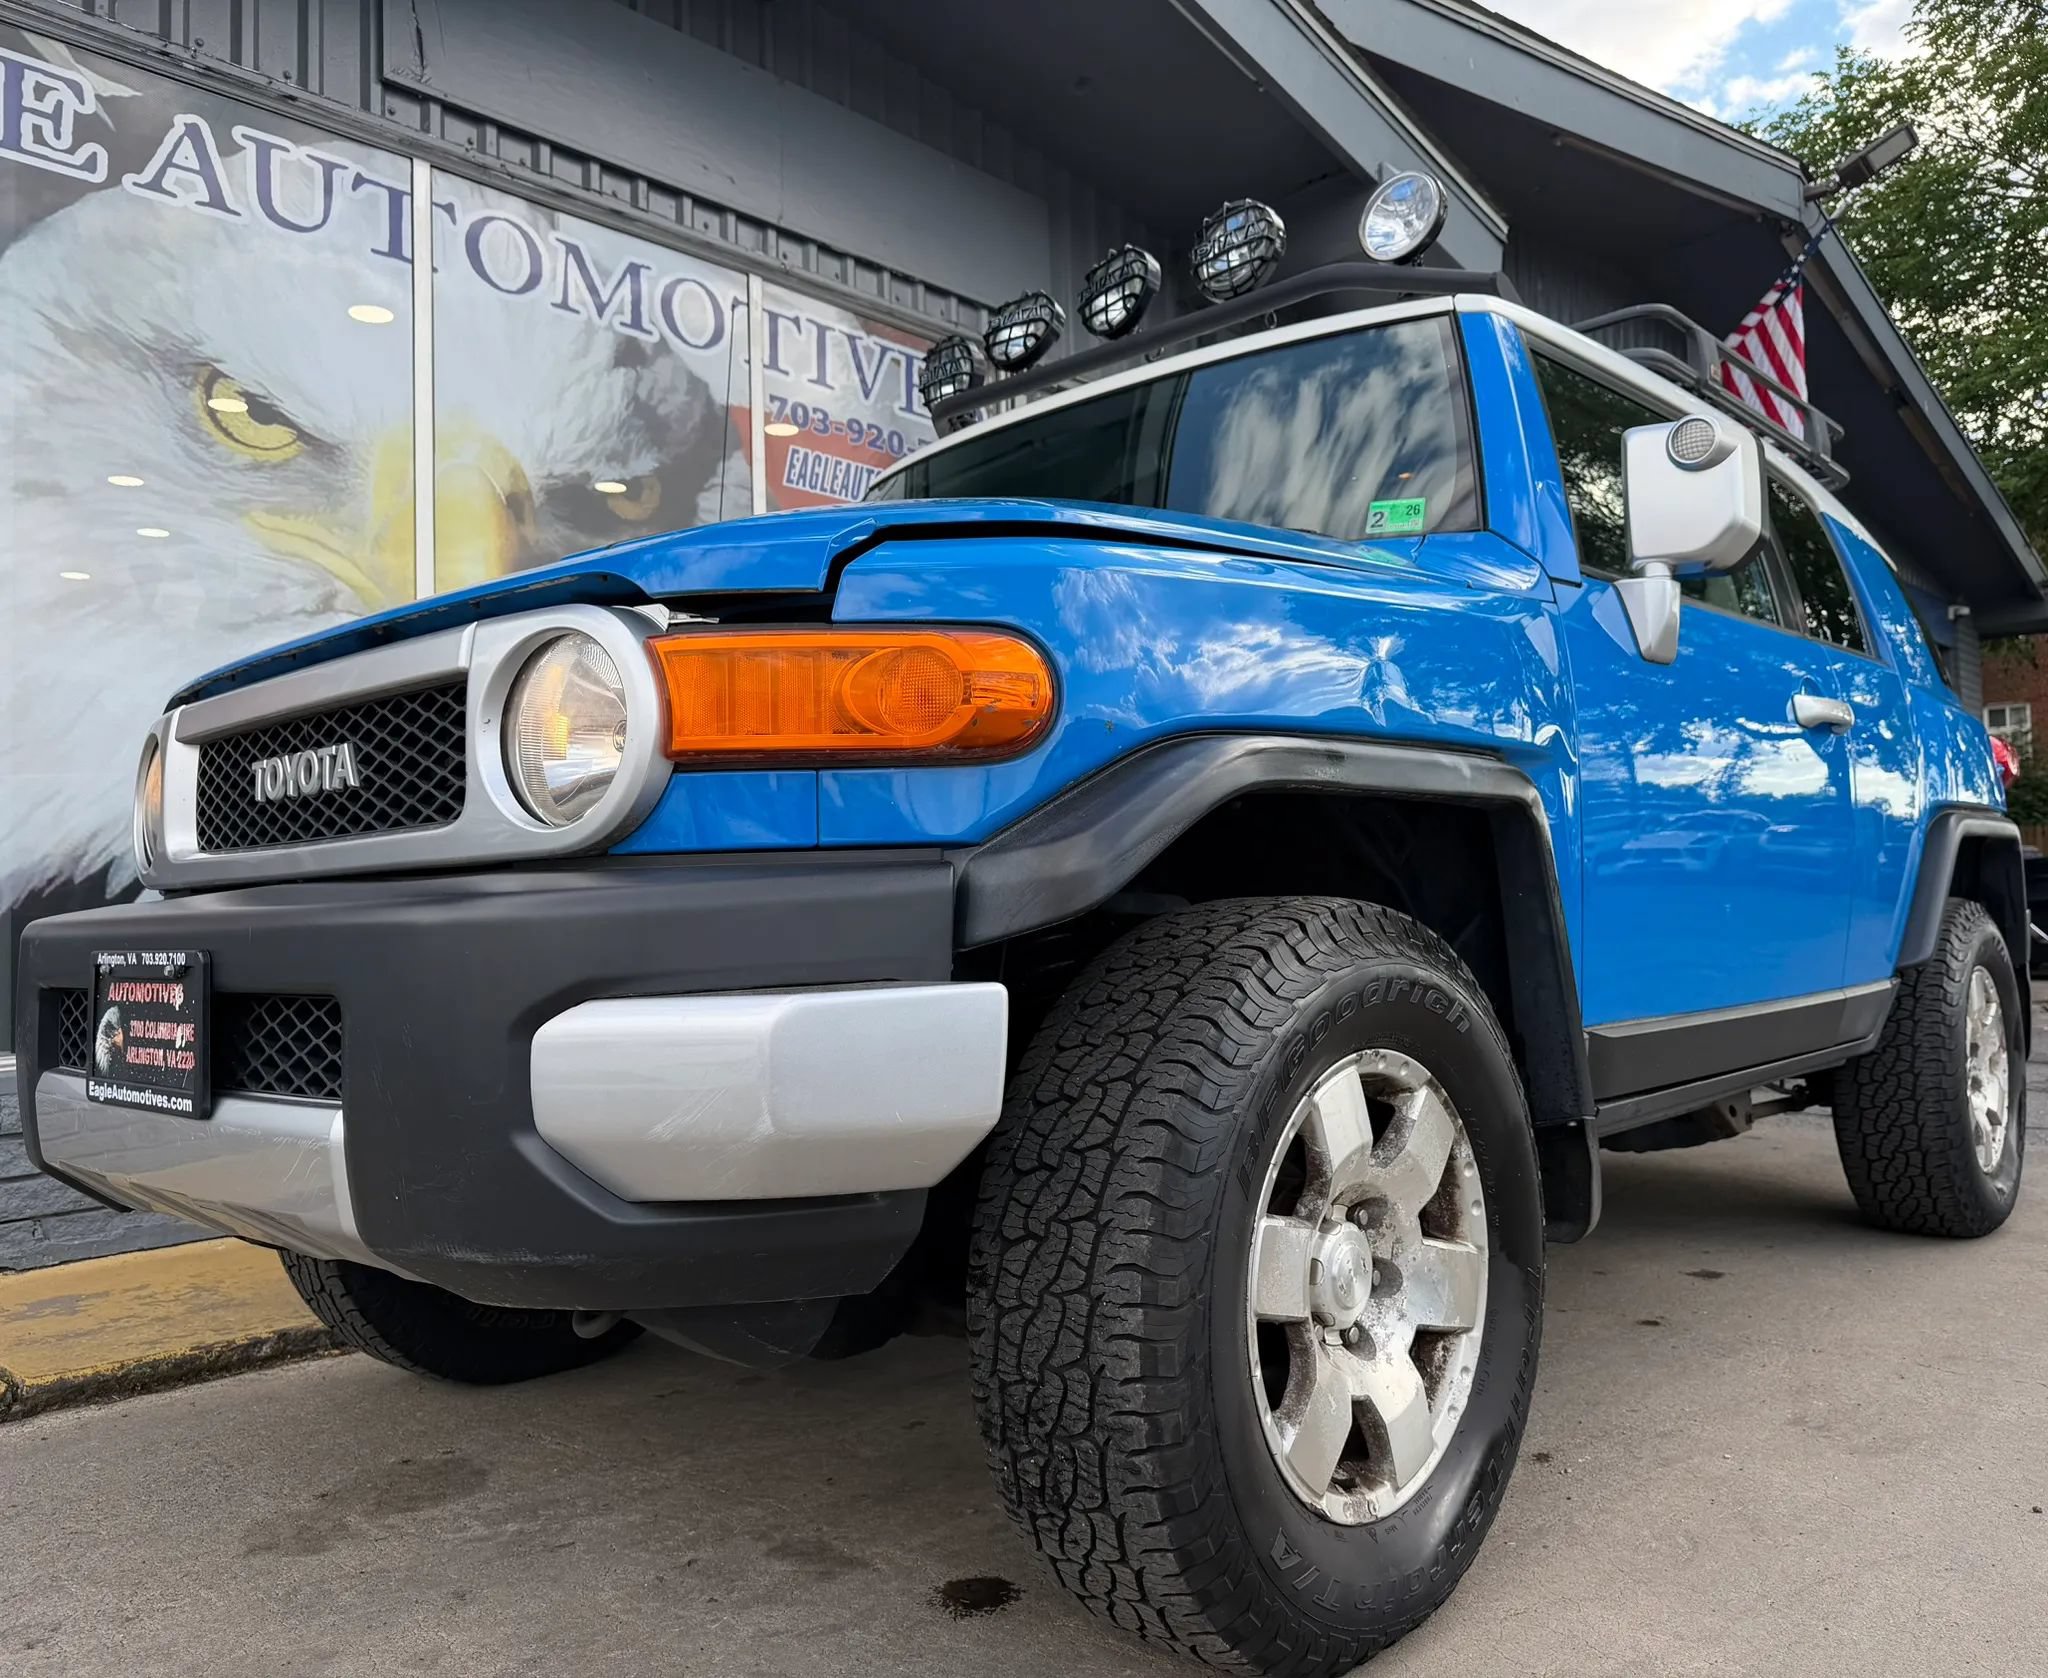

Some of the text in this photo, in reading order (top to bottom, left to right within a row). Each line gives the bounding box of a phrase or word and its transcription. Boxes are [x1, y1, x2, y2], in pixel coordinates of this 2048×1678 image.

[1191, 218, 1267, 261] PIAA
[130, 120, 938, 420] AUTOMOTIVE
[785, 446, 881, 501] EAGLEAUT
[1370, 511, 1385, 528] 2
[1405, 504, 1421, 516] 26
[251, 742, 360, 803] TOYOTA
[97, 952, 186, 967] Arlington, VA 703.920.7100
[88, 1081, 193, 1112] EagleAutomotives.com
